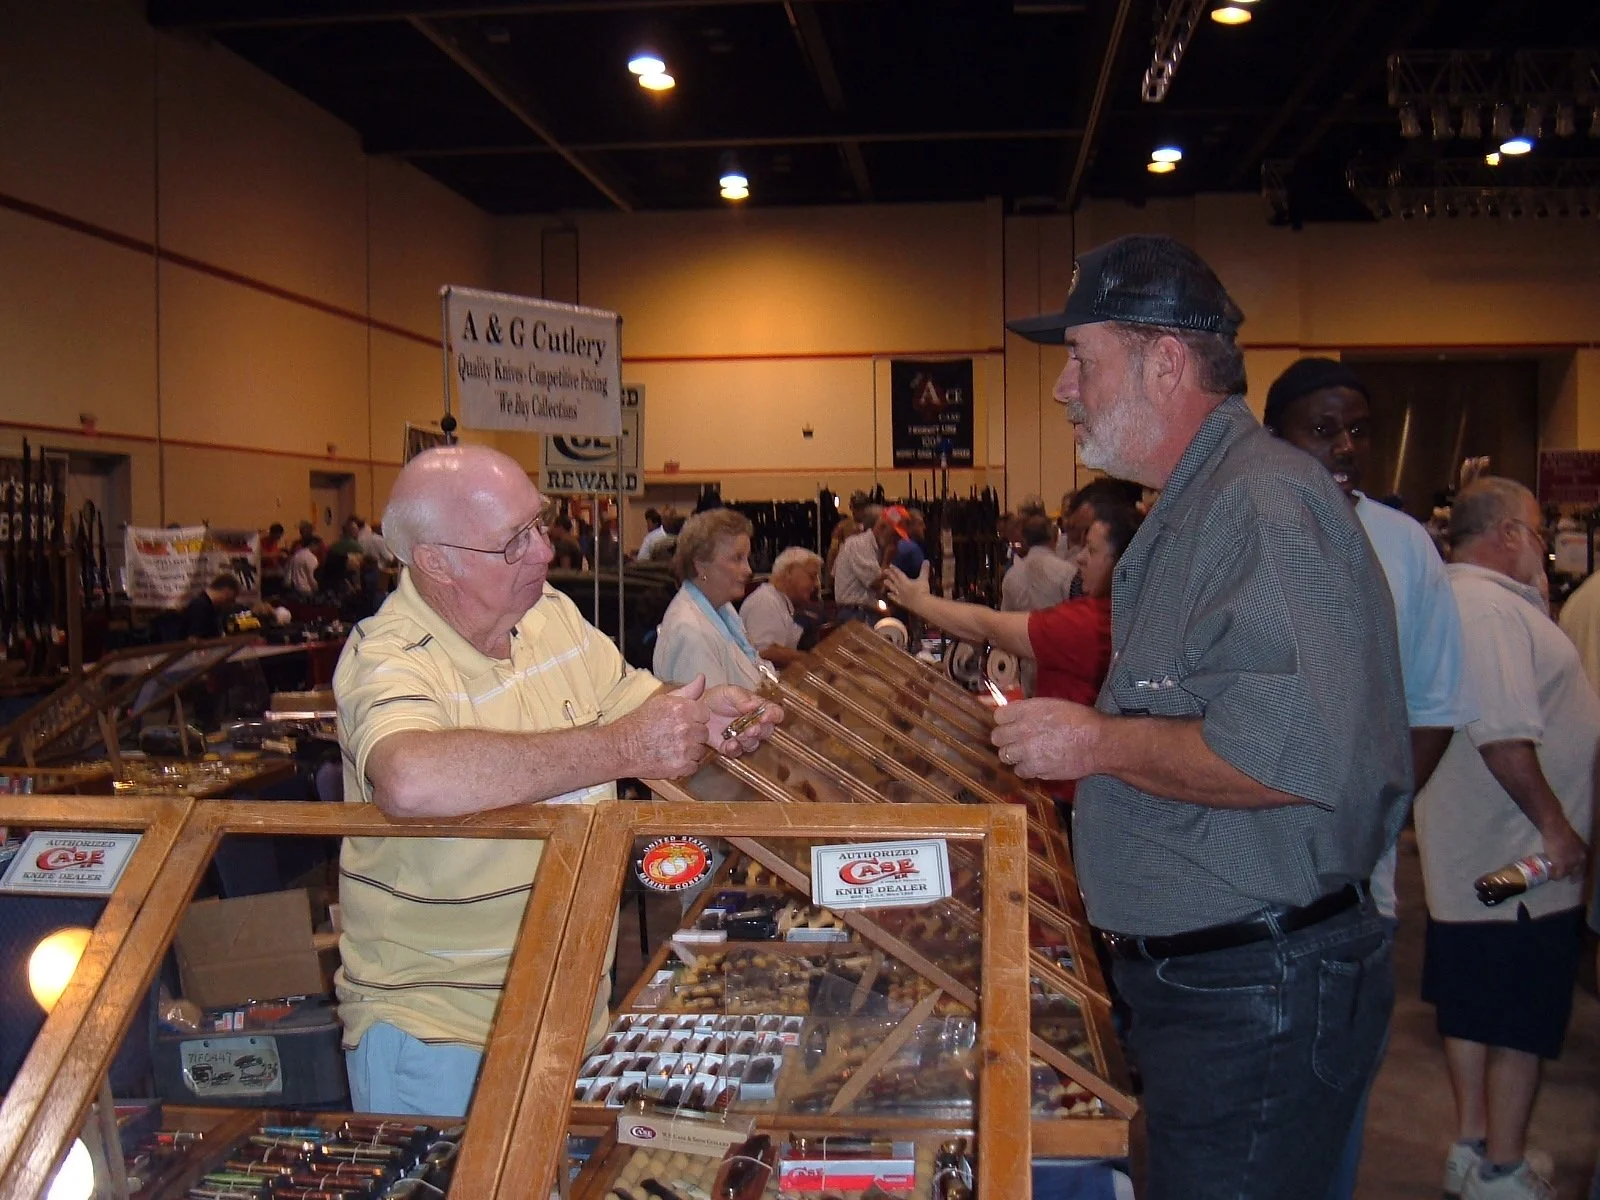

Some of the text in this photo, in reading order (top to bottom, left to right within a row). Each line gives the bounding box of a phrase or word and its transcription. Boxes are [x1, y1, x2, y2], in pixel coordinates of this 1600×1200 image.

[463, 310, 607, 365] A & G Cutlery
[458, 353, 491, 386] Quality
[528, 362, 579, 393] Competitive
[581, 368, 608, 398] Pricing
[515, 392, 529, 422] Buy
[46, 840, 115, 848] AUTHORIZED
[643, 836, 710, 853] UNITED STATES
[36, 847, 105, 871] CASE
[839, 848, 919, 860] AUTHORIZED
[23, 872, 102, 881] KNIFE DEALER
[838, 857, 921, 885] CASE
[640, 872, 705, 890] MARINE CORPS
[835, 886, 874, 896] KNIFE
[877, 883, 928, 893] DEALER
